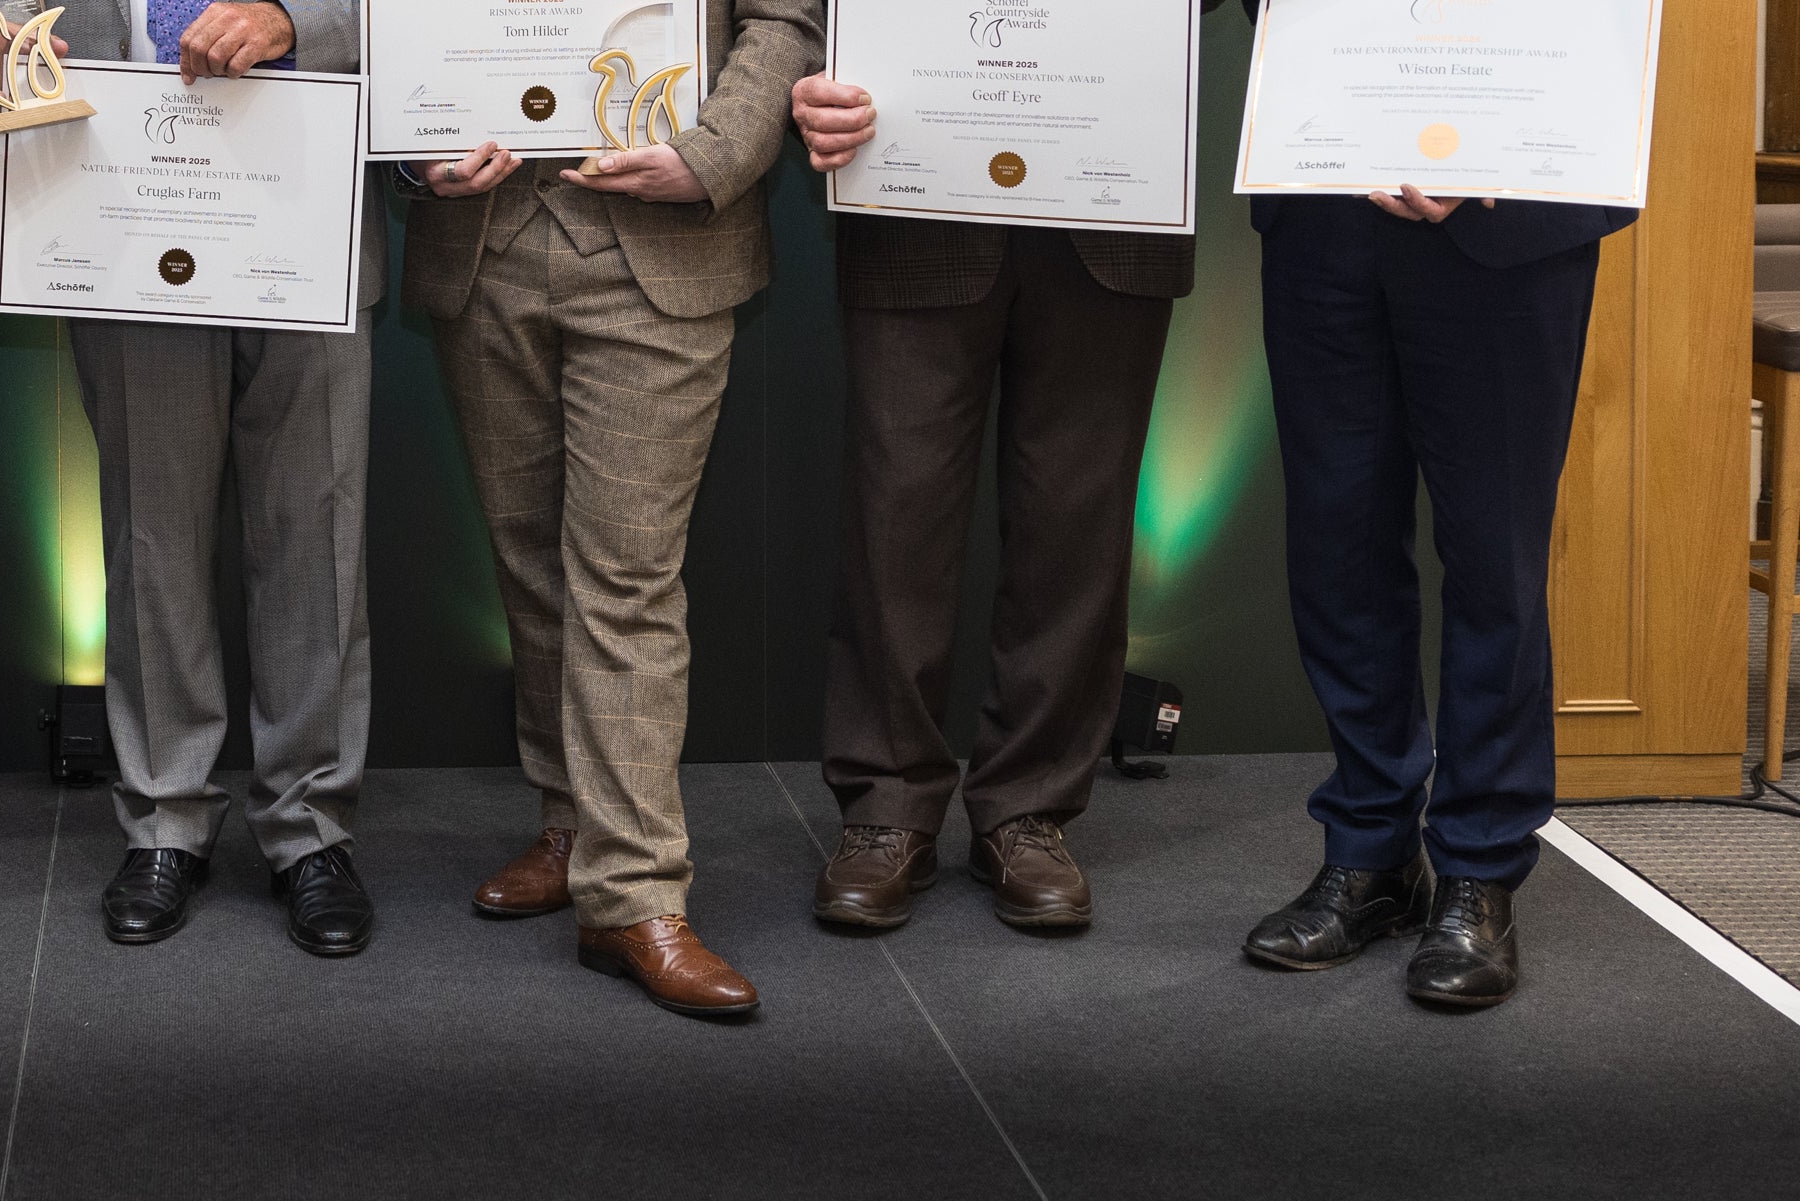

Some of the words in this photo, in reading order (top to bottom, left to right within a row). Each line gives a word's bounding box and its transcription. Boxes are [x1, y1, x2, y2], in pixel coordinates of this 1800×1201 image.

[489, 7, 521, 17] RISING
[522, 7, 547, 16] STAR
[548, 7, 583, 16] AWARD
[985, 6, 1050, 21] Countryside
[1004, 17, 1047, 30] Awards
[503, 25, 529, 38] Tom
[533, 24, 570, 37] Hilder
[1447, 46, 1524, 57] PARTNERSHIP
[1525, 49, 1568, 59] AWARD
[977, 59, 1014, 68] WINNER
[1015, 60, 1038, 69] 2025
[1398, 63, 1447, 75] Wiston
[1450, 63, 1493, 76] Estate
[912, 68, 973, 79] INNOVATION
[975, 71, 988, 80] IN
[988, 71, 1065, 83] CONSERVATION
[1067, 74, 1105, 84] AWARD
[160, 92, 203, 105] Schöffel
[972, 89, 1010, 102] Geoff
[1012, 90, 1042, 106] Eyre
[160, 102, 224, 117] Countryside
[178, 114, 221, 127] Awards
[423, 127, 460, 136] Schöffel
[151, 155, 187, 165] WINNER
[188, 157, 211, 166] 2025
[1304, 161, 1346, 170] Schöffel
[244, 172, 281, 183] AWARD
[136, 184, 185, 200] Cruglas
[188, 187, 221, 201] Farm
[888, 184, 926, 194] Schöffel
[55, 282, 94, 293] Schöffel
